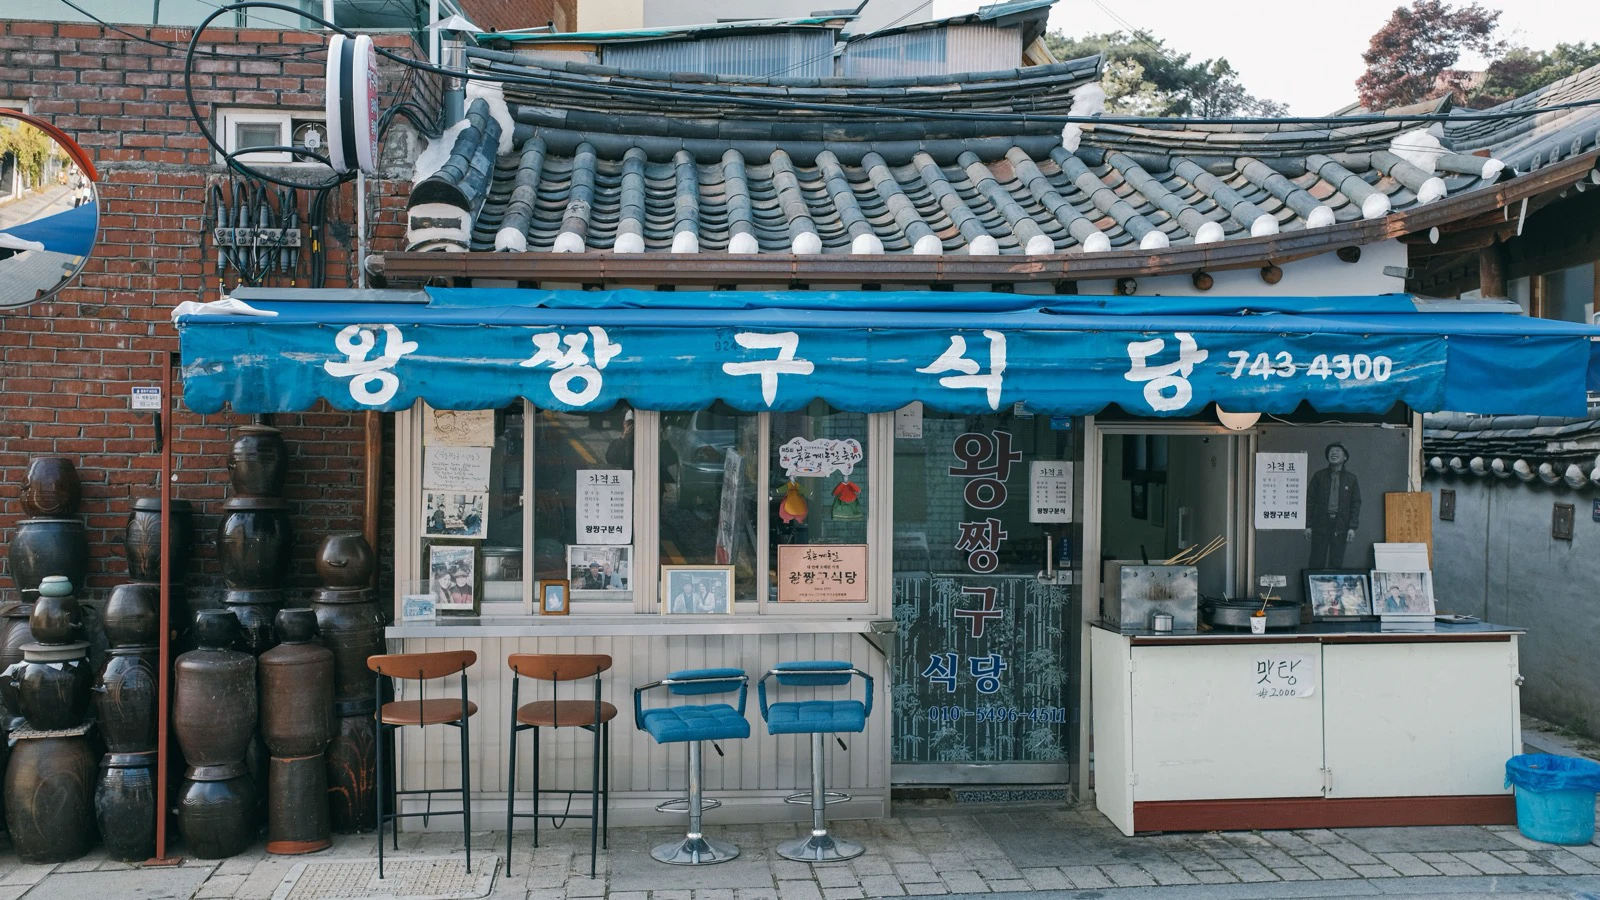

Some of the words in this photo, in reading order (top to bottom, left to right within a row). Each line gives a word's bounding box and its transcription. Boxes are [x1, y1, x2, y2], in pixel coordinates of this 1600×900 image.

[1228, 350, 1296, 380] 743
[1306, 354, 1392, 382] 4300
[1263, 510, 1298, 519] 왕짱구분식
[585, 525, 623, 534] 왕짱구분식
